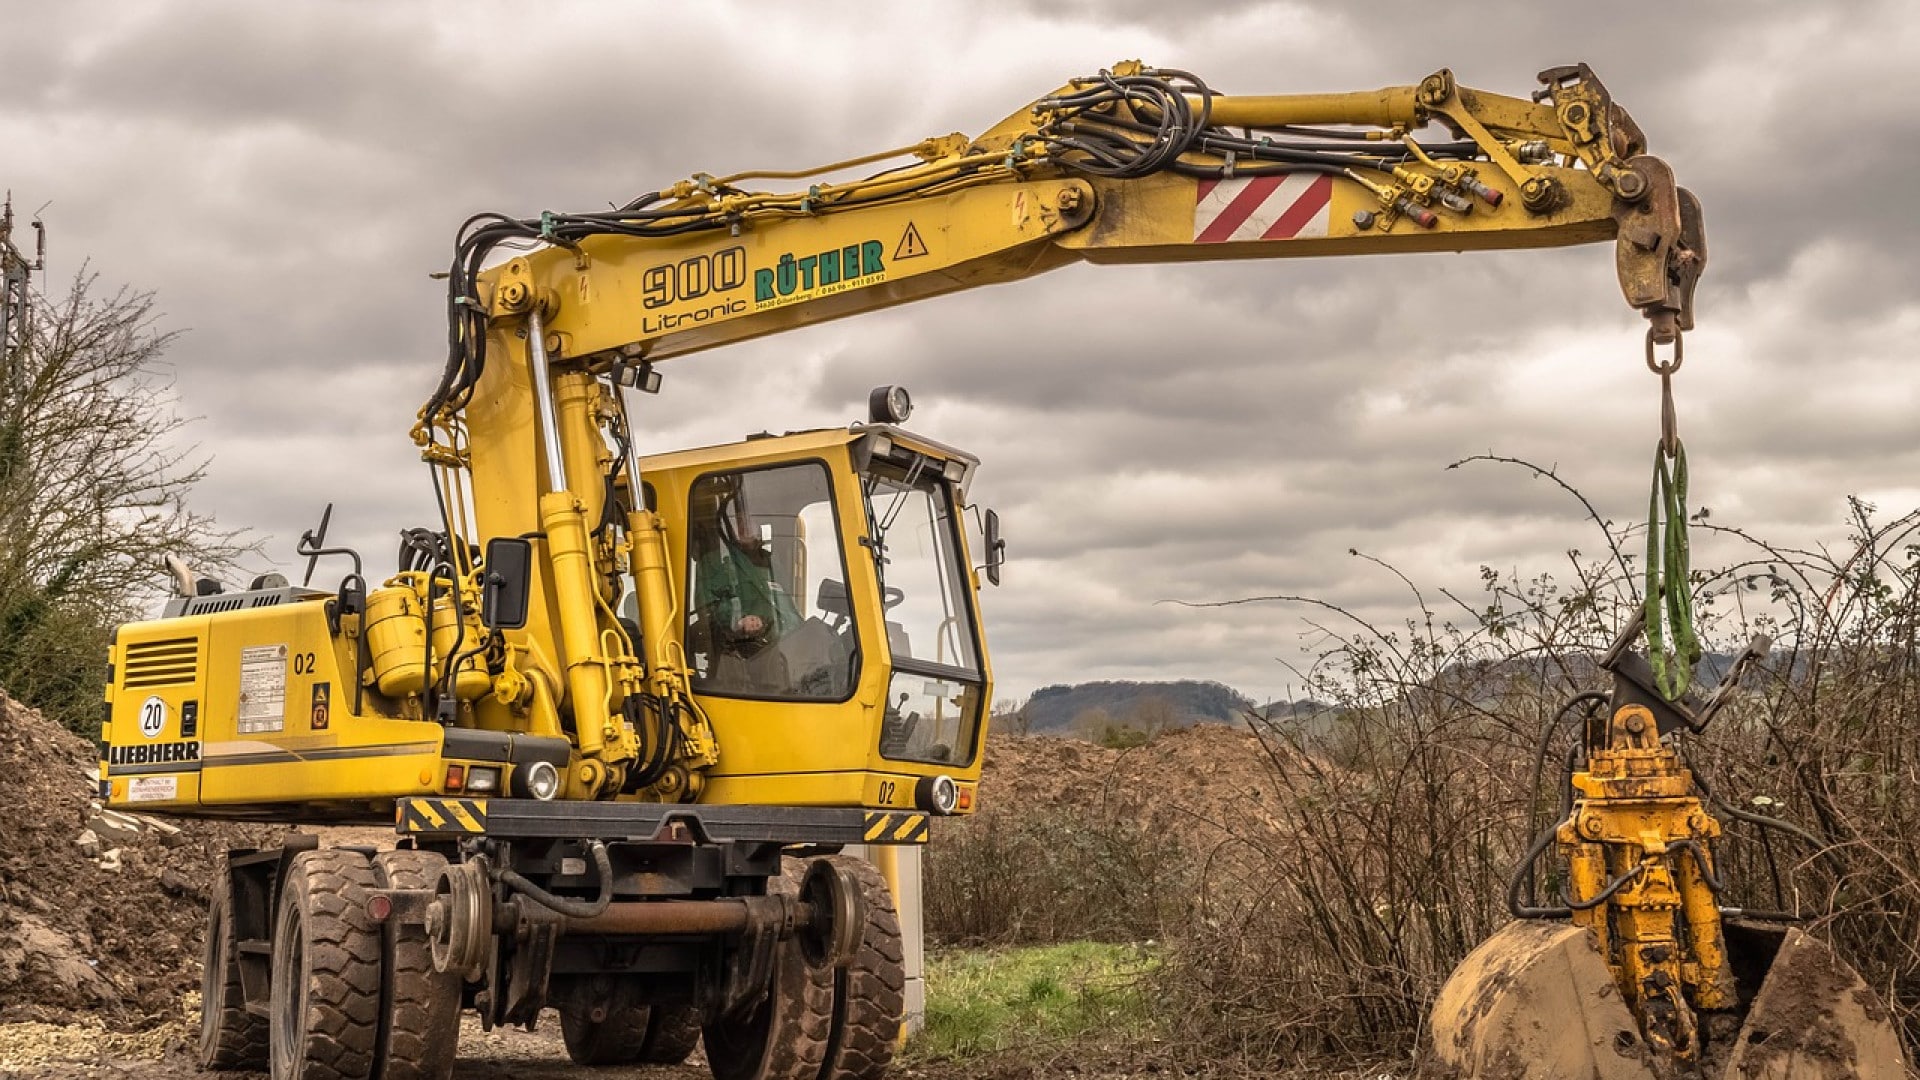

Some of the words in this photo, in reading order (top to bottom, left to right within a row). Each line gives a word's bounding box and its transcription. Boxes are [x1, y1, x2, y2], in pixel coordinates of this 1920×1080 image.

[643, 246, 746, 309] 900
[754, 240, 885, 303] RÜTHER
[643, 297, 747, 333] Litronic
[294, 652, 316, 675] 02
[144, 703, 162, 730] 20
[110, 741, 199, 765] LIEBHERR
[879, 780, 895, 804] 02
